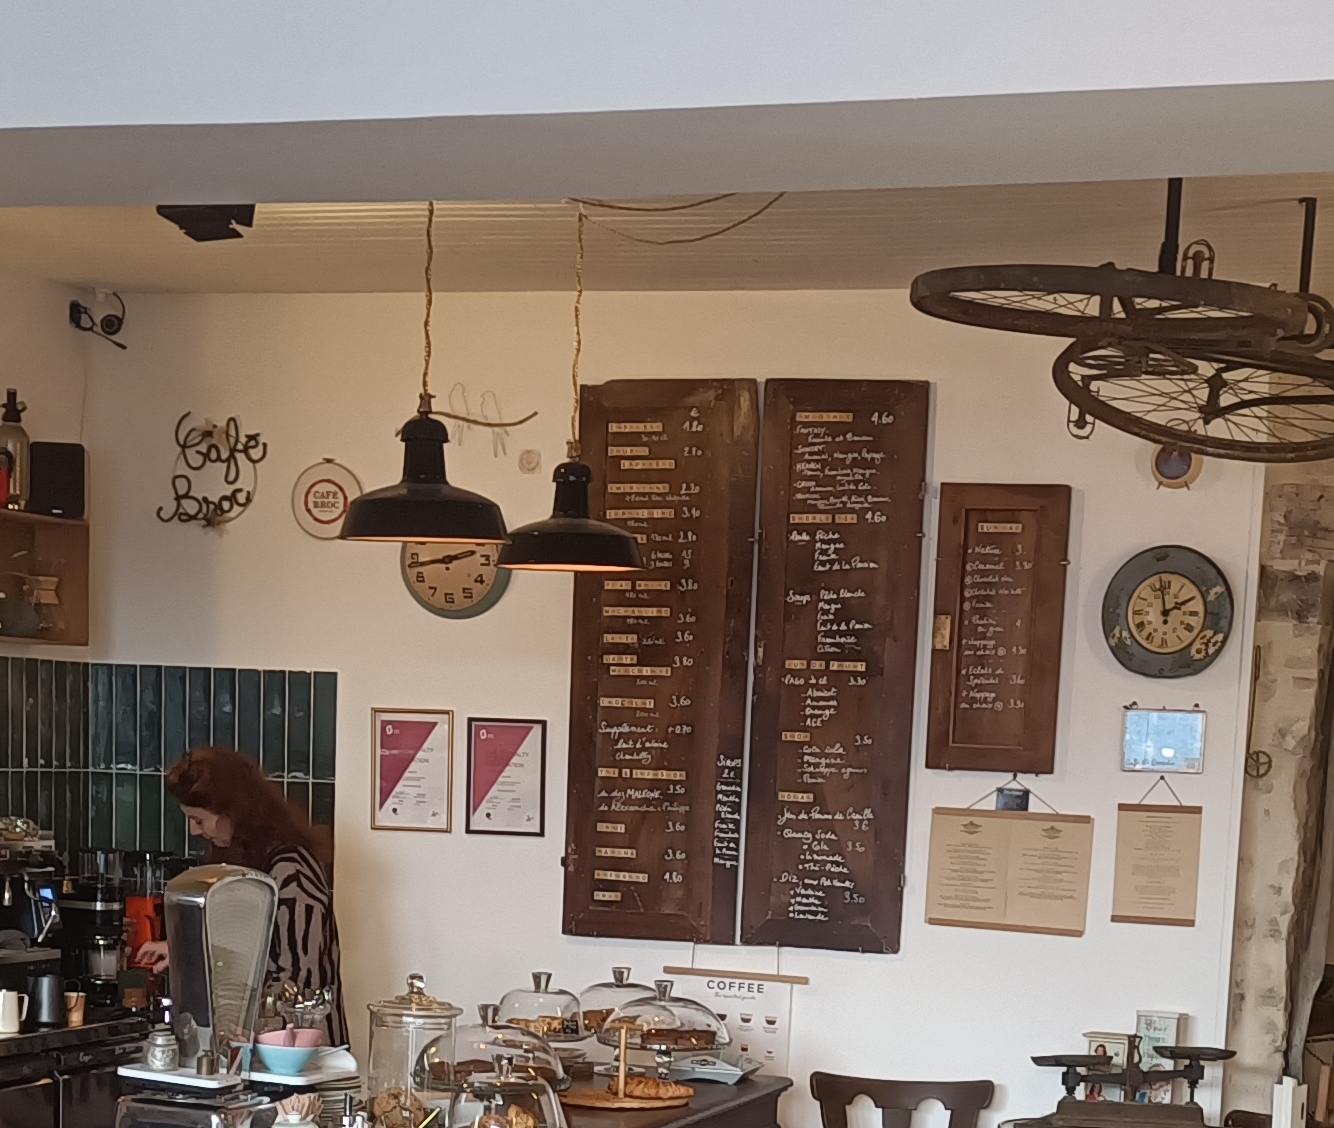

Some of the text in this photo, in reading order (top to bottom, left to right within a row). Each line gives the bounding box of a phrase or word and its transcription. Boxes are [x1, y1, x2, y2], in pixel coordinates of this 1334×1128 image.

[870, 412, 894, 425] 4.60
[174, 411, 267, 484] Café
[157, 475, 252, 523] Broc
[313, 501, 340, 510] BROC
[865, 511, 886, 523] 4.60
[480, 554, 490, 566] 3
[416, 572, 425, 583] 8
[474, 574, 485, 585] 4
[428, 586, 437, 597] 7
[462, 587, 473, 599] 5
[444, 592, 455, 604] 6
[669, 695, 691, 708] 3.60
[805, 707, 837, 720] Orange
[806, 718, 823, 727] ACE
[707, 980, 765, 993] COFFEE
